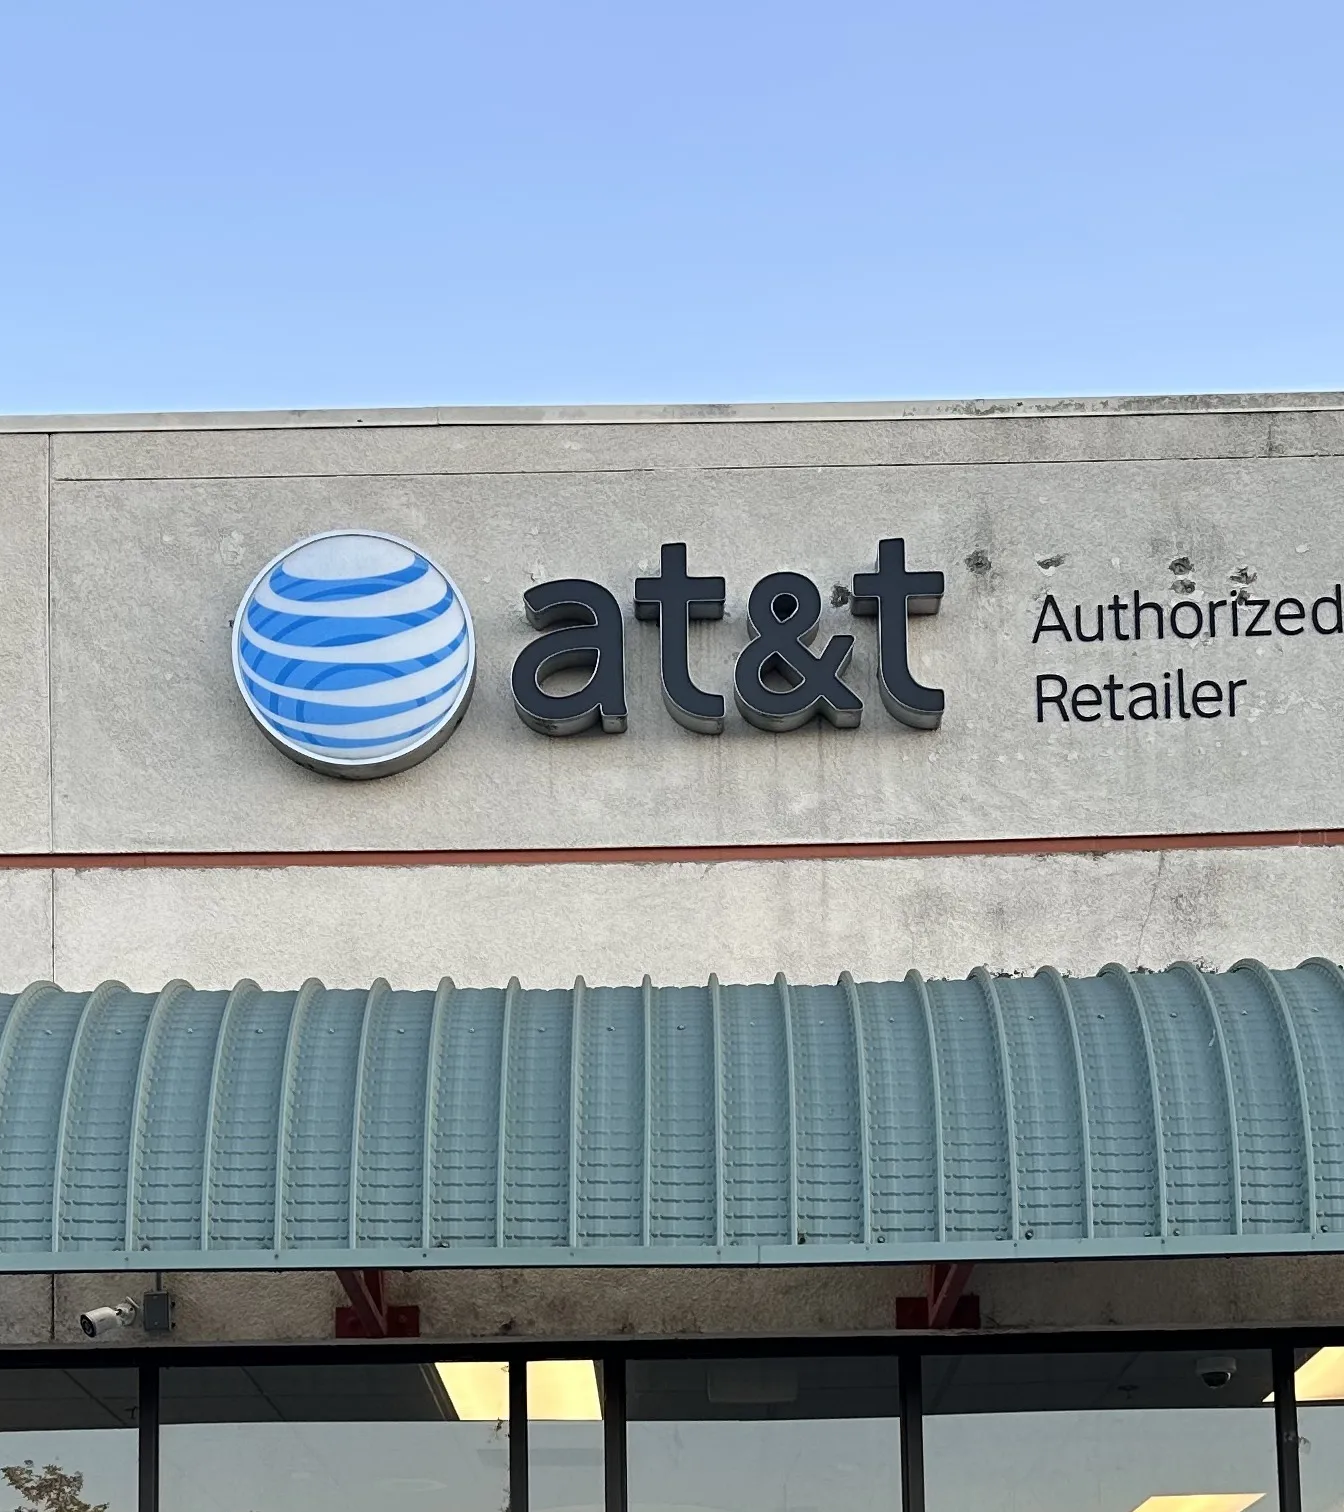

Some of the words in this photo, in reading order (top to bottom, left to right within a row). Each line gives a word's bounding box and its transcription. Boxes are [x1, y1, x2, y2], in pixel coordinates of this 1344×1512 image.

[510, 537, 945, 730] at&t
[1032, 583, 1344, 643] Authorized
[1036, 668, 1248, 722] Retailer
